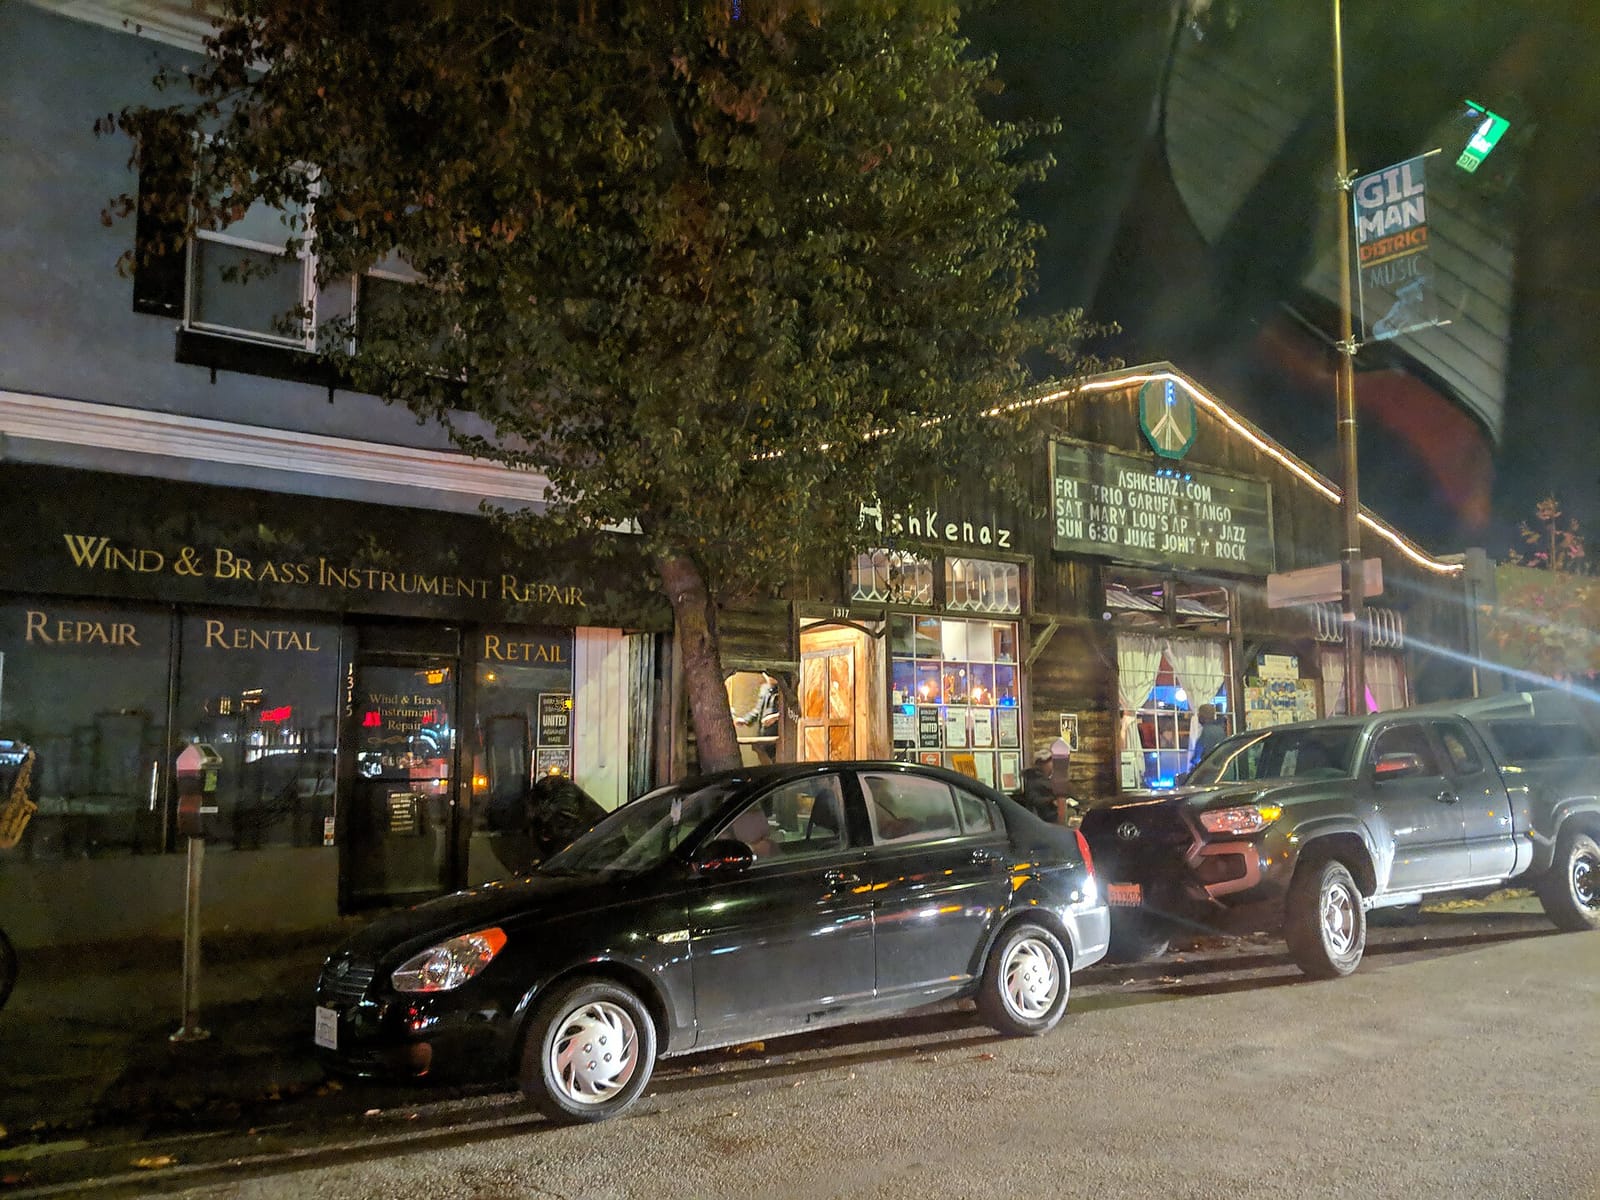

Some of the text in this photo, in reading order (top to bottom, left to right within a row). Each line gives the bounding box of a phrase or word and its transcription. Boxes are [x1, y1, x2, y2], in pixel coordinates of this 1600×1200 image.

[1356, 163, 1425, 209] GIL
[1359, 196, 1426, 244] MAN
[1359, 227, 1427, 260] DISTRICT
[1370, 255, 1420, 289] MUSIC
[1056, 478, 1078, 498] FRI
[1092, 484, 1123, 504] TRIO
[1128, 491, 1177, 514] GARUFA
[1193, 502, 1232, 523] TANGO
[1118, 470, 1212, 502] ASHKENAZ.COM
[1056, 498, 1083, 518] SAT
[1090, 503, 1126, 526] MARY
[1133, 511, 1168, 532] LOU'S
[1219, 523, 1246, 543] JAZZ
[1056, 518, 1083, 539] SUN
[1088, 524, 1118, 543] 6:30
[1124, 528, 1156, 549] JUKE
[1216, 540, 1246, 560] ROCK
[64, 534, 586, 607] WIND & BRASS INSTRUMENT REPAIR
[24, 609, 141, 647] REPAIR
[205, 619, 321, 651] RENTAL
[484, 634, 567, 663] RETAIL
[542, 714, 568, 727] UNITED
